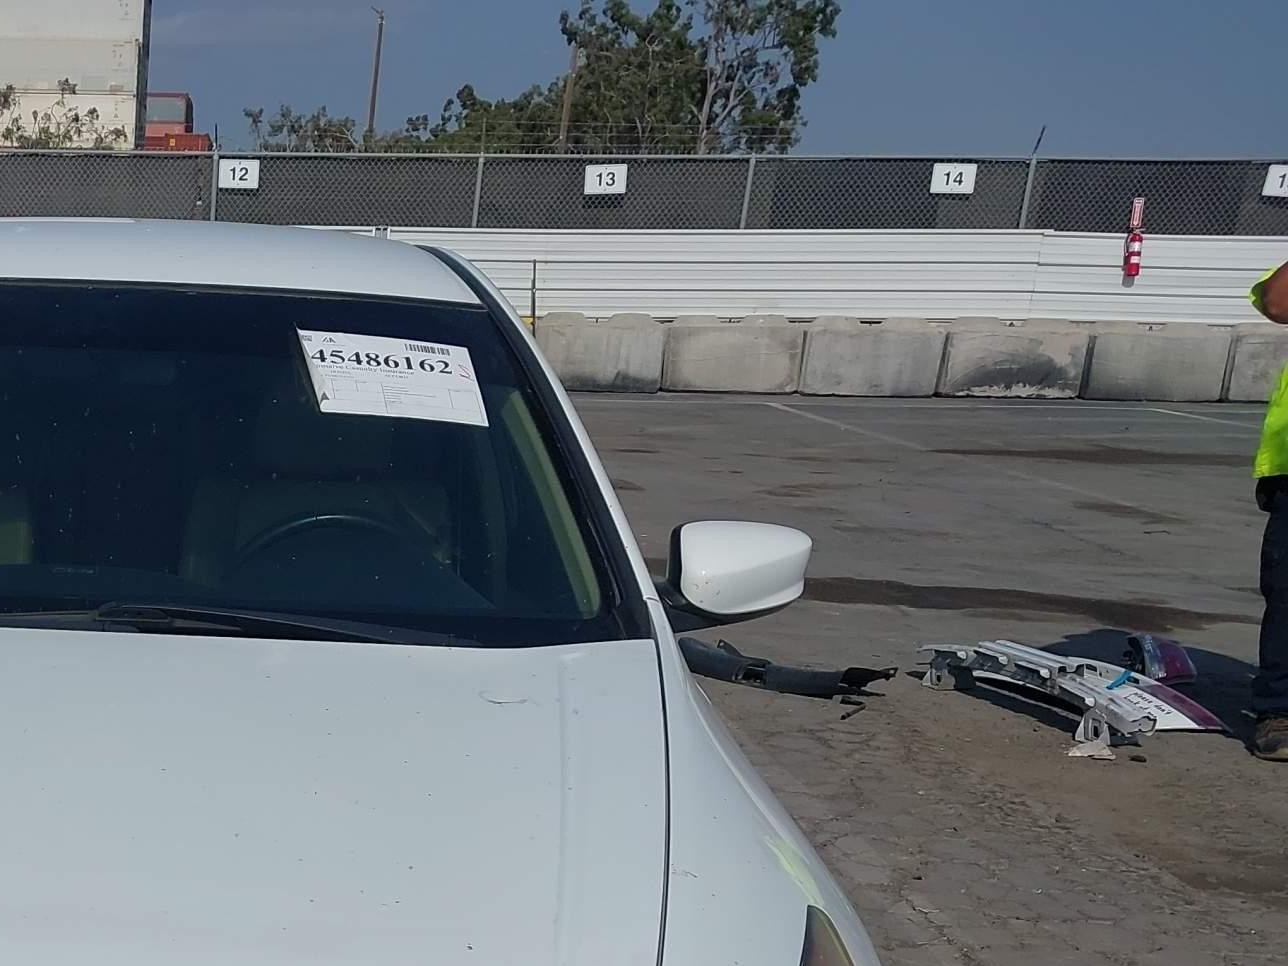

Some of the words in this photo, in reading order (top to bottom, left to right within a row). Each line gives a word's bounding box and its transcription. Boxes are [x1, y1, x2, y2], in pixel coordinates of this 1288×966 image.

[229, 166, 249, 181] 12
[595, 171, 616, 187] 13
[943, 170, 964, 186] 14
[1278, 172, 1288, 189] 1
[310, 347, 453, 375] 45486162
